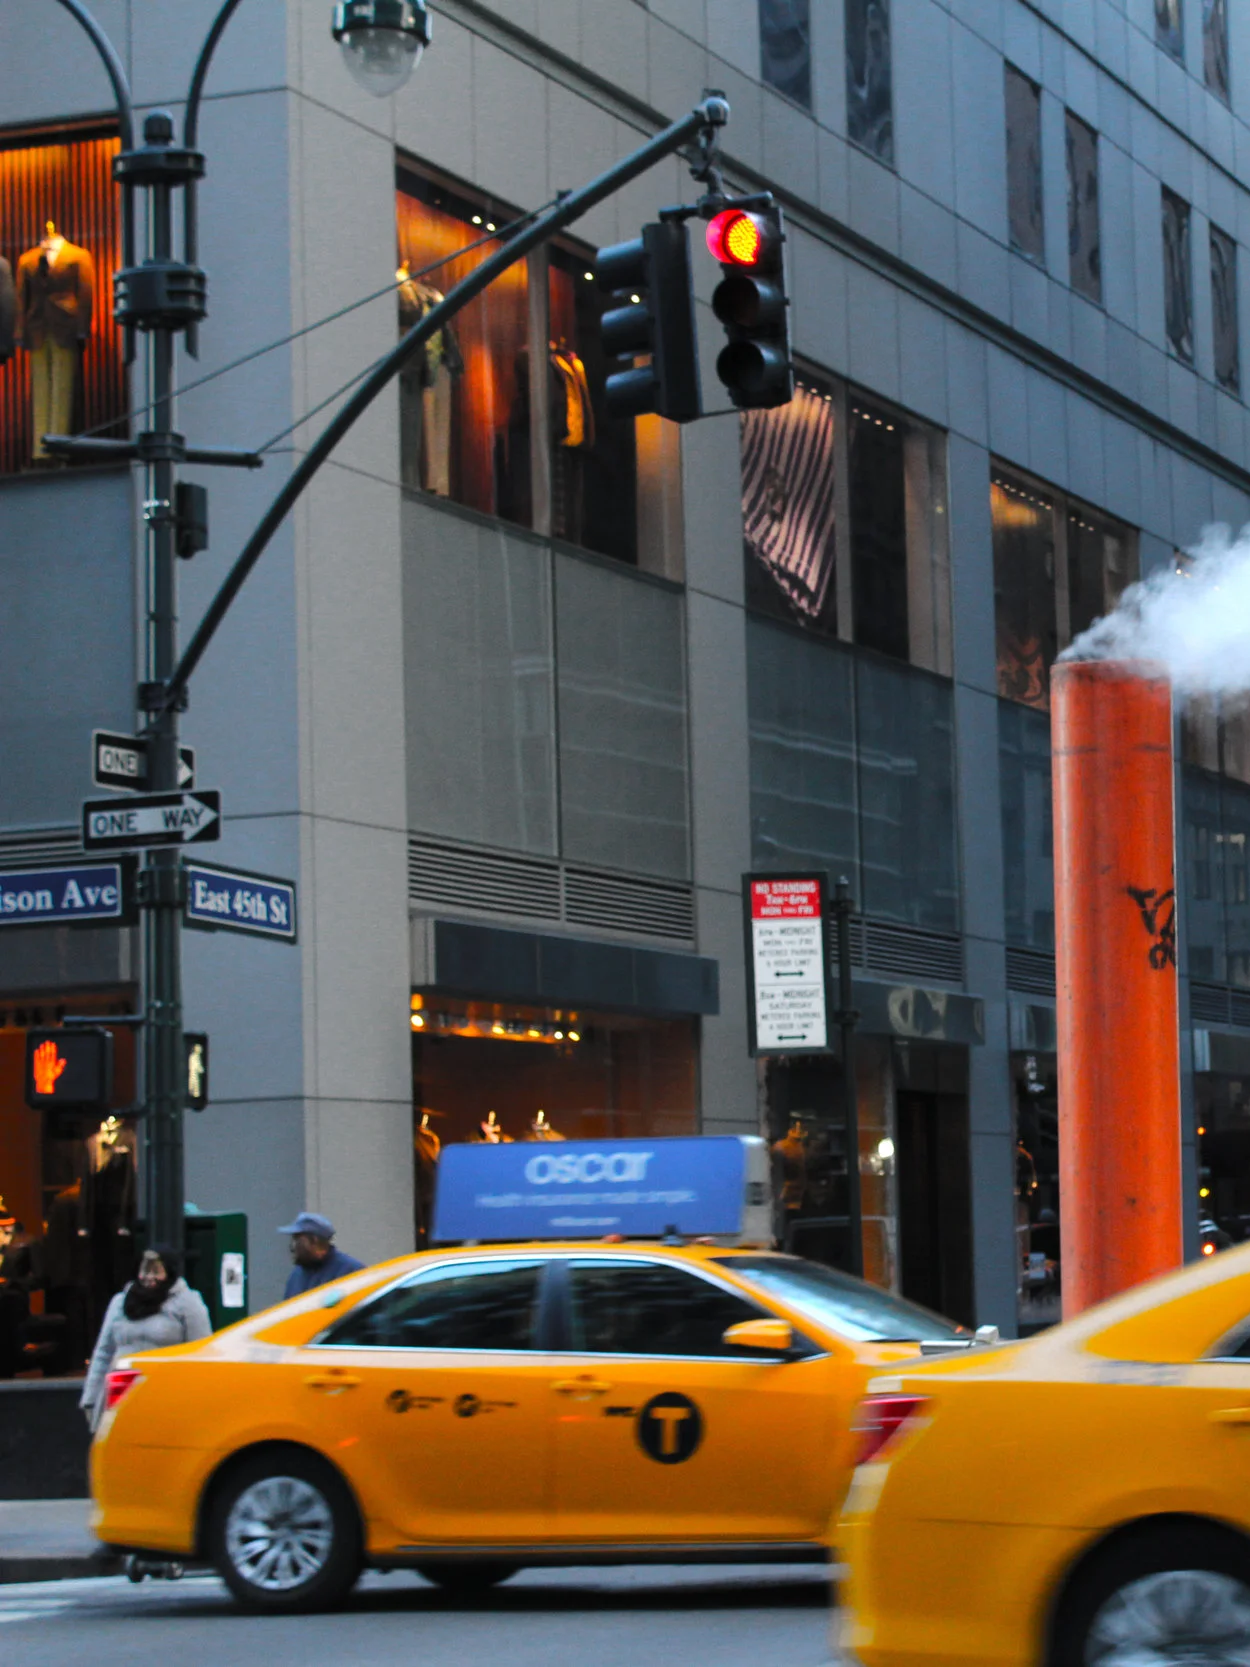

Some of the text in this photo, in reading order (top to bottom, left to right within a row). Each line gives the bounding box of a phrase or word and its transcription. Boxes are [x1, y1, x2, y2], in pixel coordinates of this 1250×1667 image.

[101, 749, 138, 775] ONE
[93, 807, 206, 836] ONE WAY
[0, 878, 118, 913] son Ave
[194, 880, 288, 926] East 45th St
[755, 881, 817, 895] NO STANDING
[524, 1152, 654, 1185] oscar
[648, 1406, 691, 1456] T
